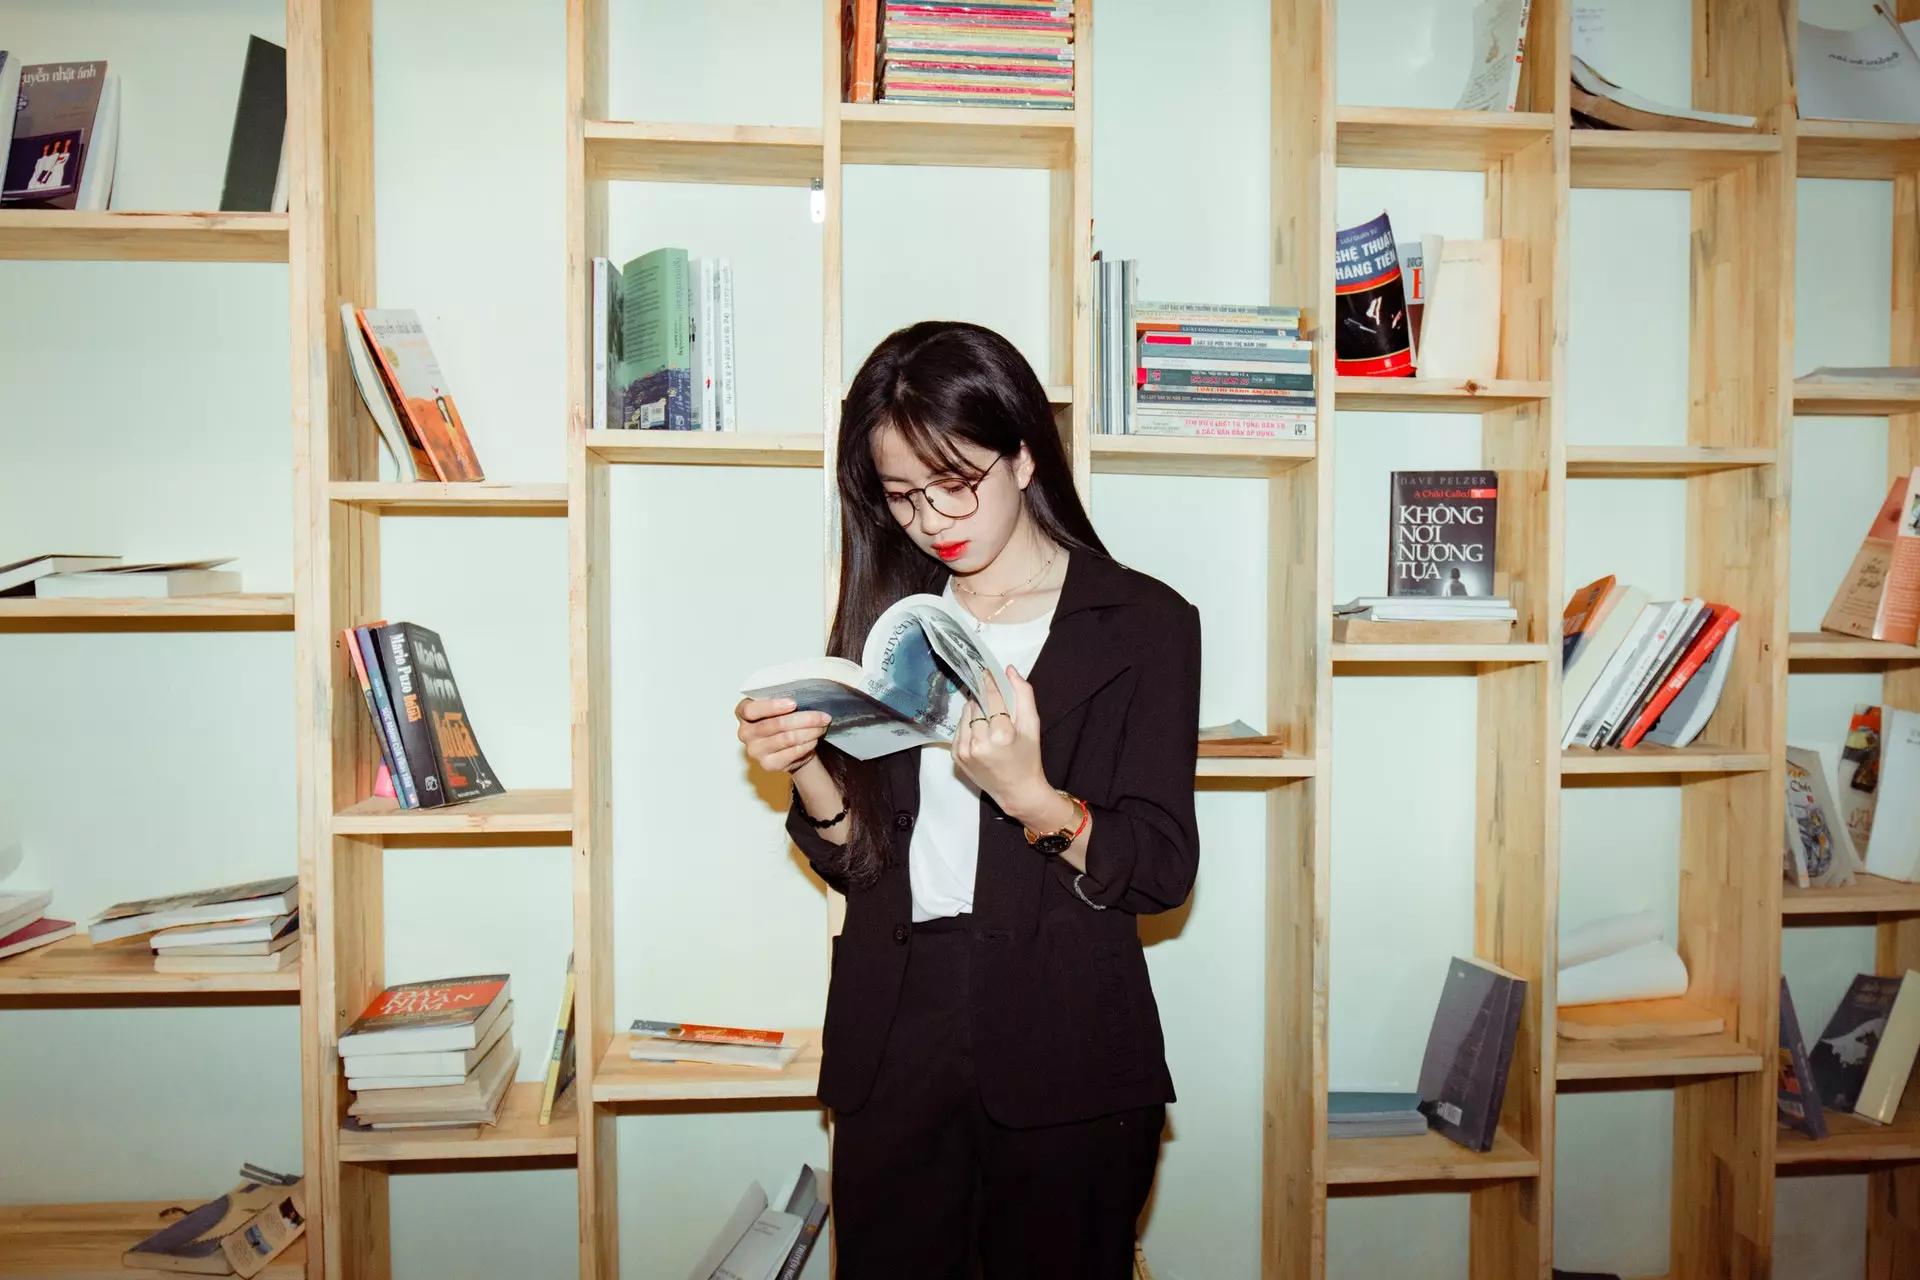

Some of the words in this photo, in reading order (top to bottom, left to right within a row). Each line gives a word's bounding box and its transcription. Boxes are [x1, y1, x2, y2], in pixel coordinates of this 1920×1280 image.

[1400, 477, 1433, 486] DAVE
[1440, 476, 1487, 486] PELZER
[1423, 488, 1444, 498] Child
[1398, 503, 1484, 525] KHÔNG
[1398, 525, 1442, 543] NƠI
[1398, 542, 1484, 562] NƯƠNG
[1396, 561, 1442, 582] TỰA
[389, 633, 408, 666] Mario
[397, 665, 413, 694] Puzo
